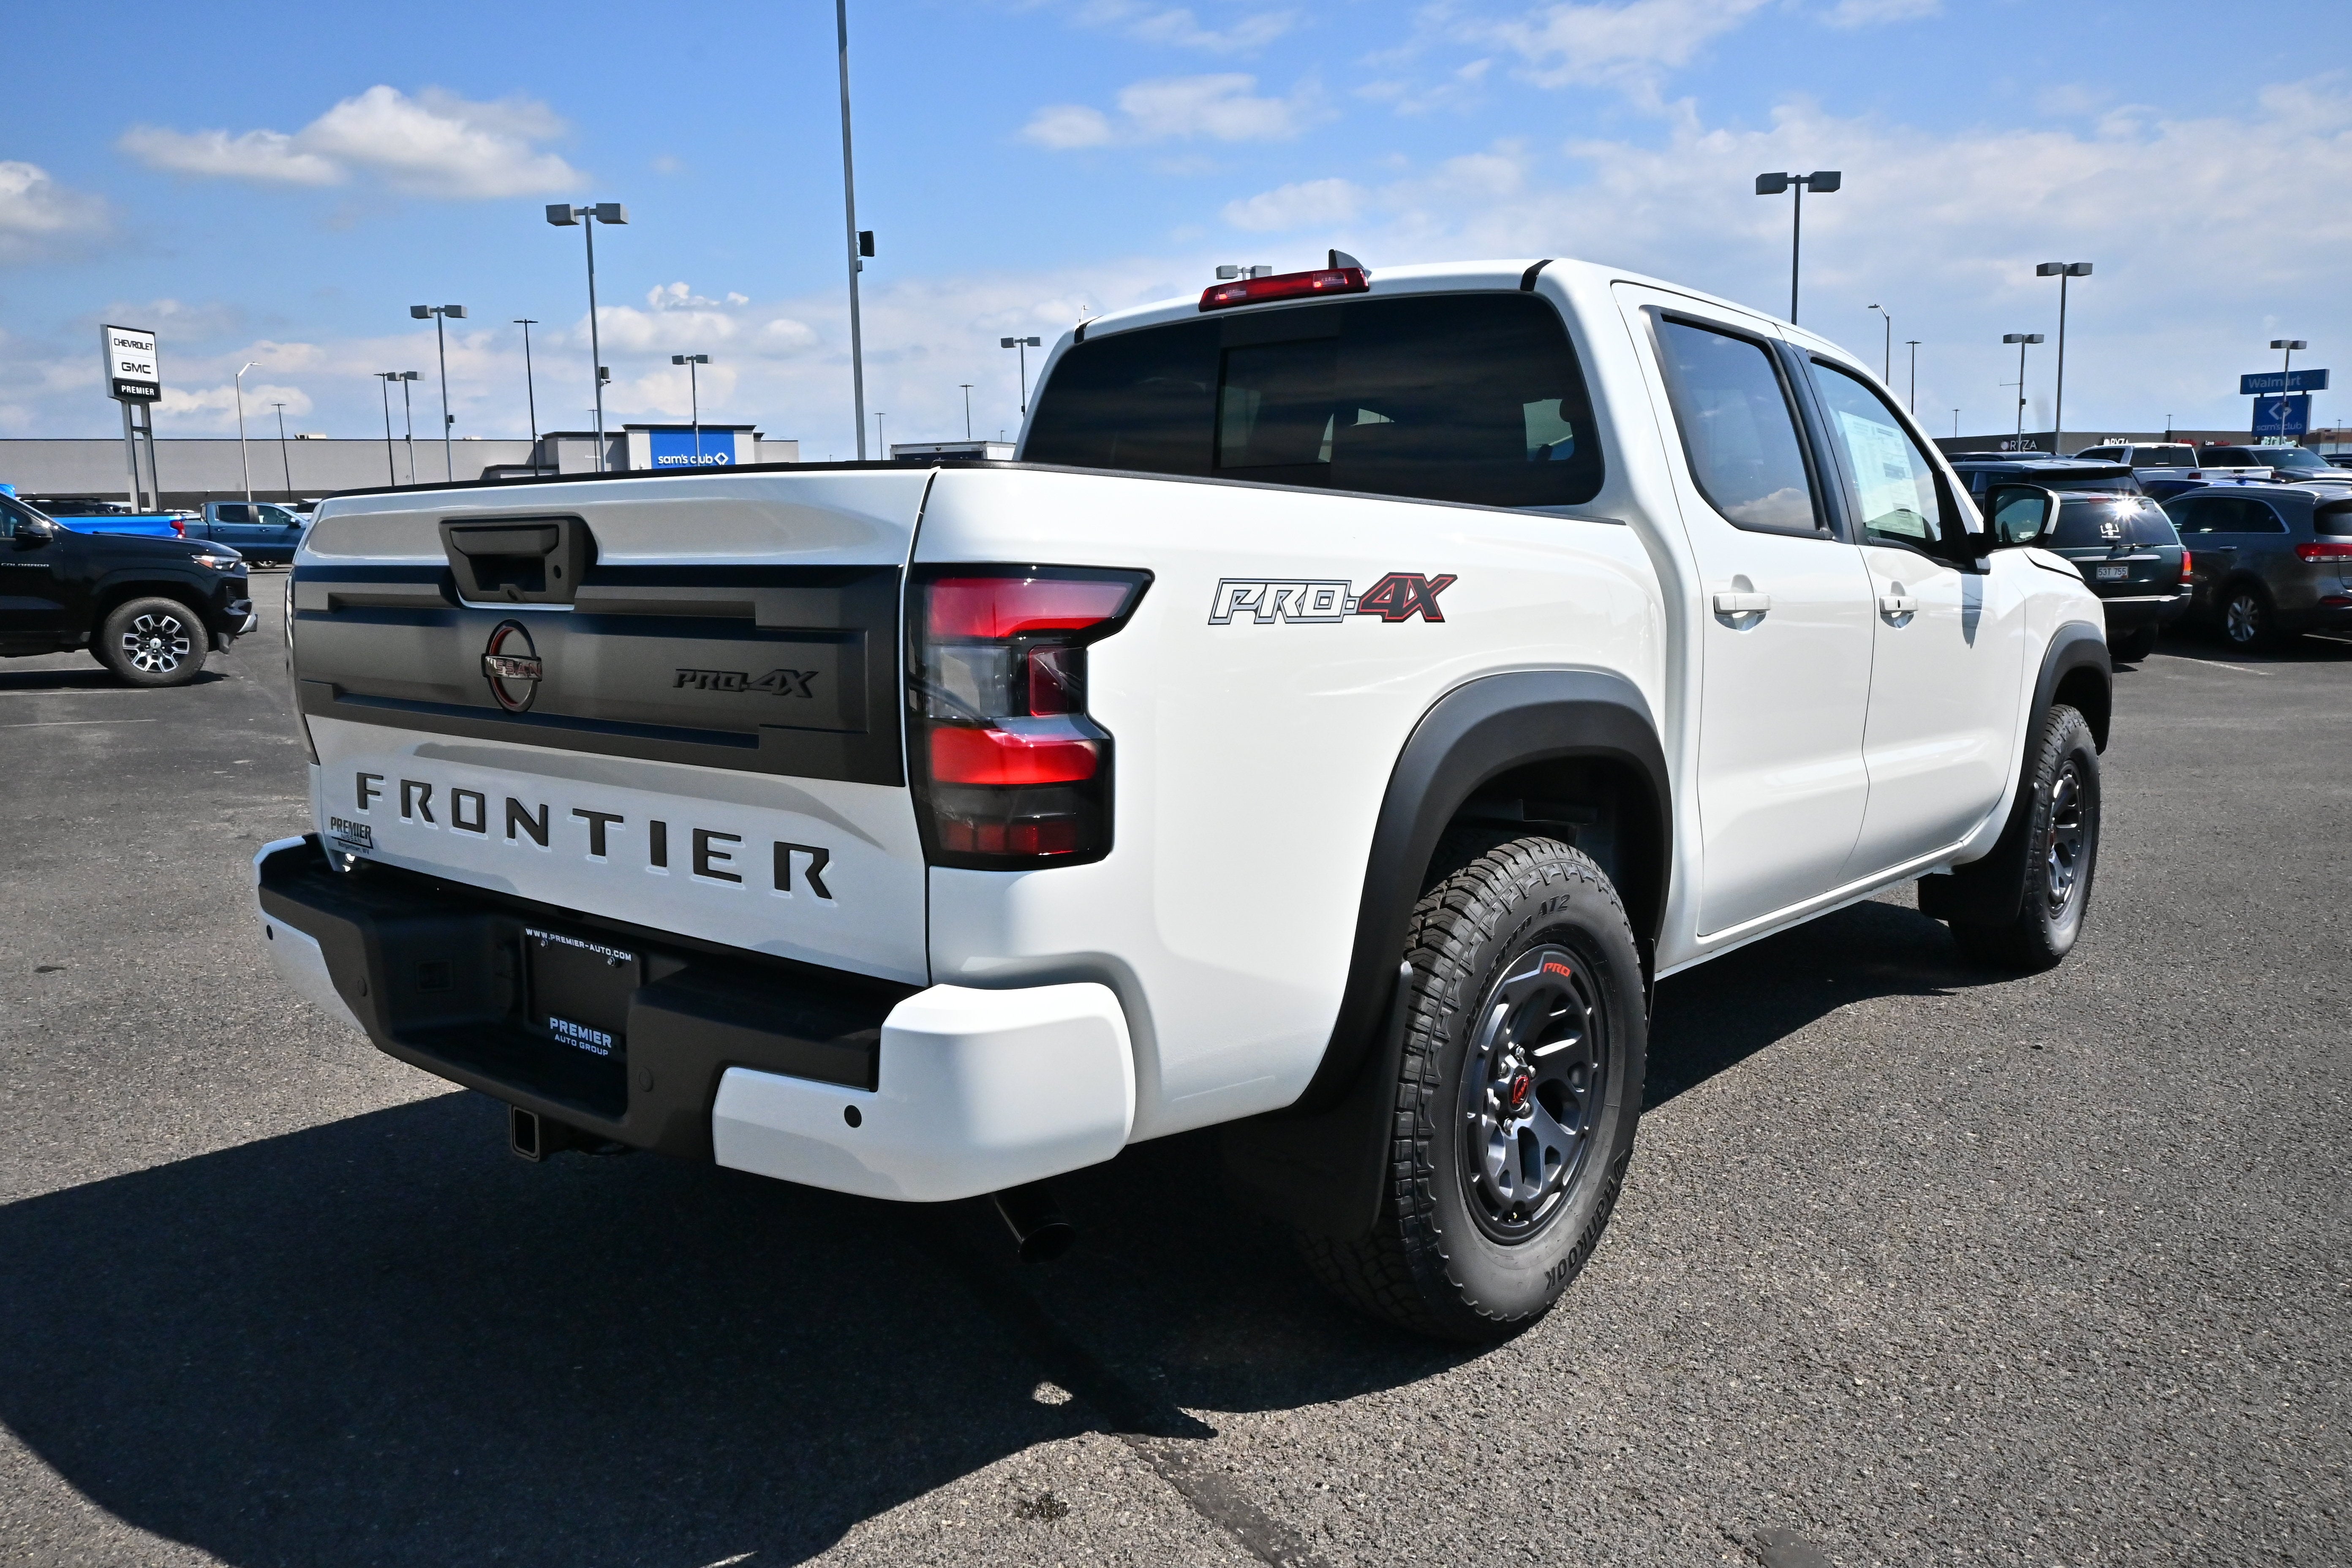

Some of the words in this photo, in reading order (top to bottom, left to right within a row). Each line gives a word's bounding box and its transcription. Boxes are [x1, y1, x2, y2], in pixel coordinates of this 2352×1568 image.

[114, 338, 153, 351] CHEVROLET
[121, 362, 151, 374] GMC
[121, 385, 155, 395] PREMIER
[658, 454, 688, 464] sam's
[690, 453, 713, 464] cub
[1208, 572, 1458, 625] PRO-4X
[330, 816, 371, 840] PREMIER
[357, 772, 833, 900] FRONTIER
[1536, 893, 1571, 919] AT2
[525, 928, 632, 961] WWW.PREMIER-AUTO.COM
[1543, 962, 1571, 977] PRO
[550, 1017, 612, 1048] PREMIER
[554, 1034, 577, 1047] AUTO
[579, 1041, 608, 1056] GROUP
